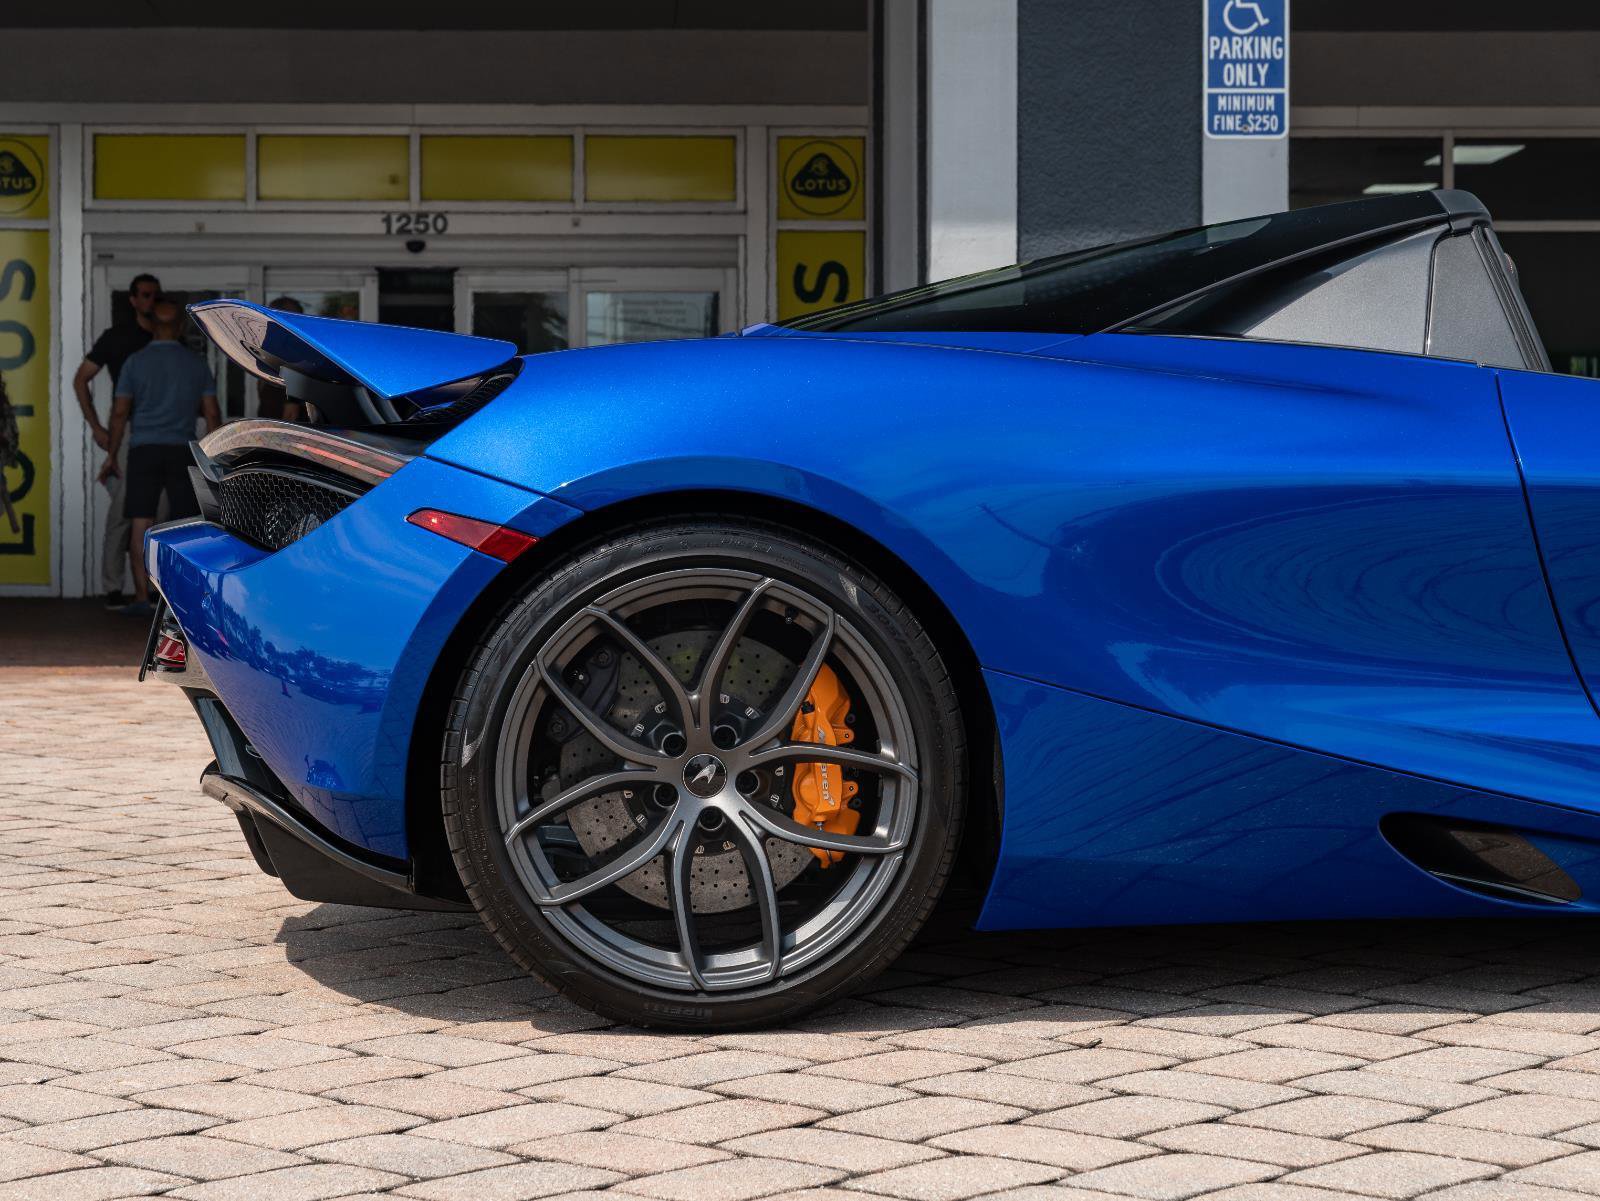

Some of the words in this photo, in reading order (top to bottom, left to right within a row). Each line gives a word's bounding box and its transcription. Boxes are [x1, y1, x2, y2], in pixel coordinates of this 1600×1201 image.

[1209, 36, 1284, 59] PARKING
[1223, 63, 1269, 86] ONLY
[1218, 95, 1275, 111] MINIMUM
[1213, 114, 1243, 131] FINE
[1247, 113, 1279, 132] $250
[0, 176, 32, 189] TUS
[794, 178, 848, 191] LOTUS
[381, 212, 449, 235] 1250
